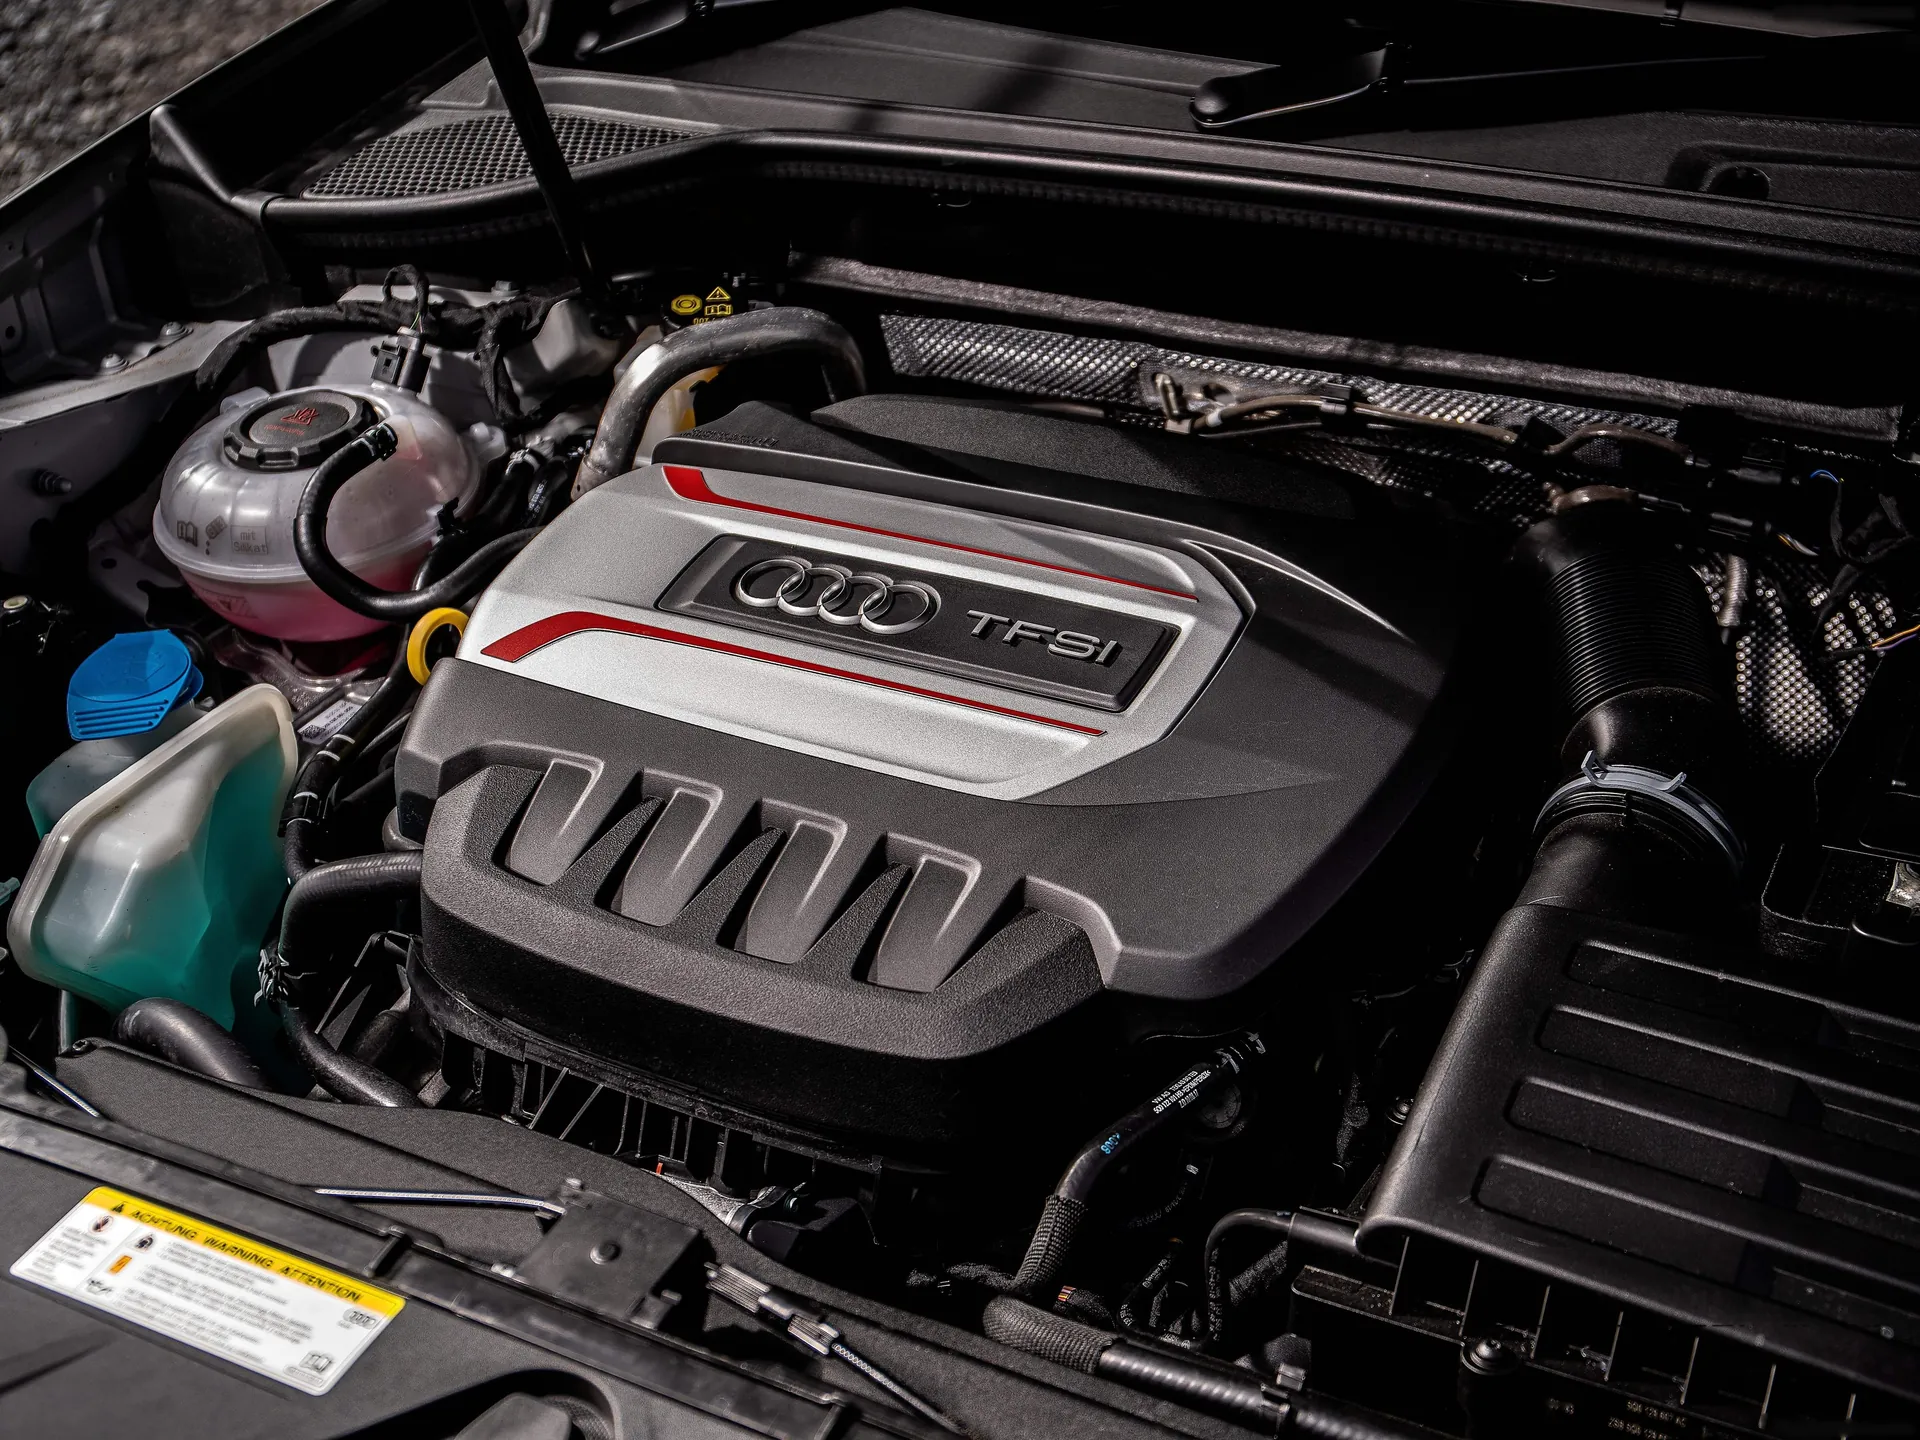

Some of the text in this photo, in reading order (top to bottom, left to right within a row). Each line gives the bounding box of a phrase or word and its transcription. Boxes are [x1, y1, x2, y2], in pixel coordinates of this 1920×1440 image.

[233, 541, 267, 553] Silikat
[240, 529, 256, 541] mit
[967, 609, 1120, 665] TFSI
[131, 1210, 198, 1240] ACHTUNG
[203, 1236, 273, 1269] WARNING
[280, 1266, 361, 1302] ATTENTION
